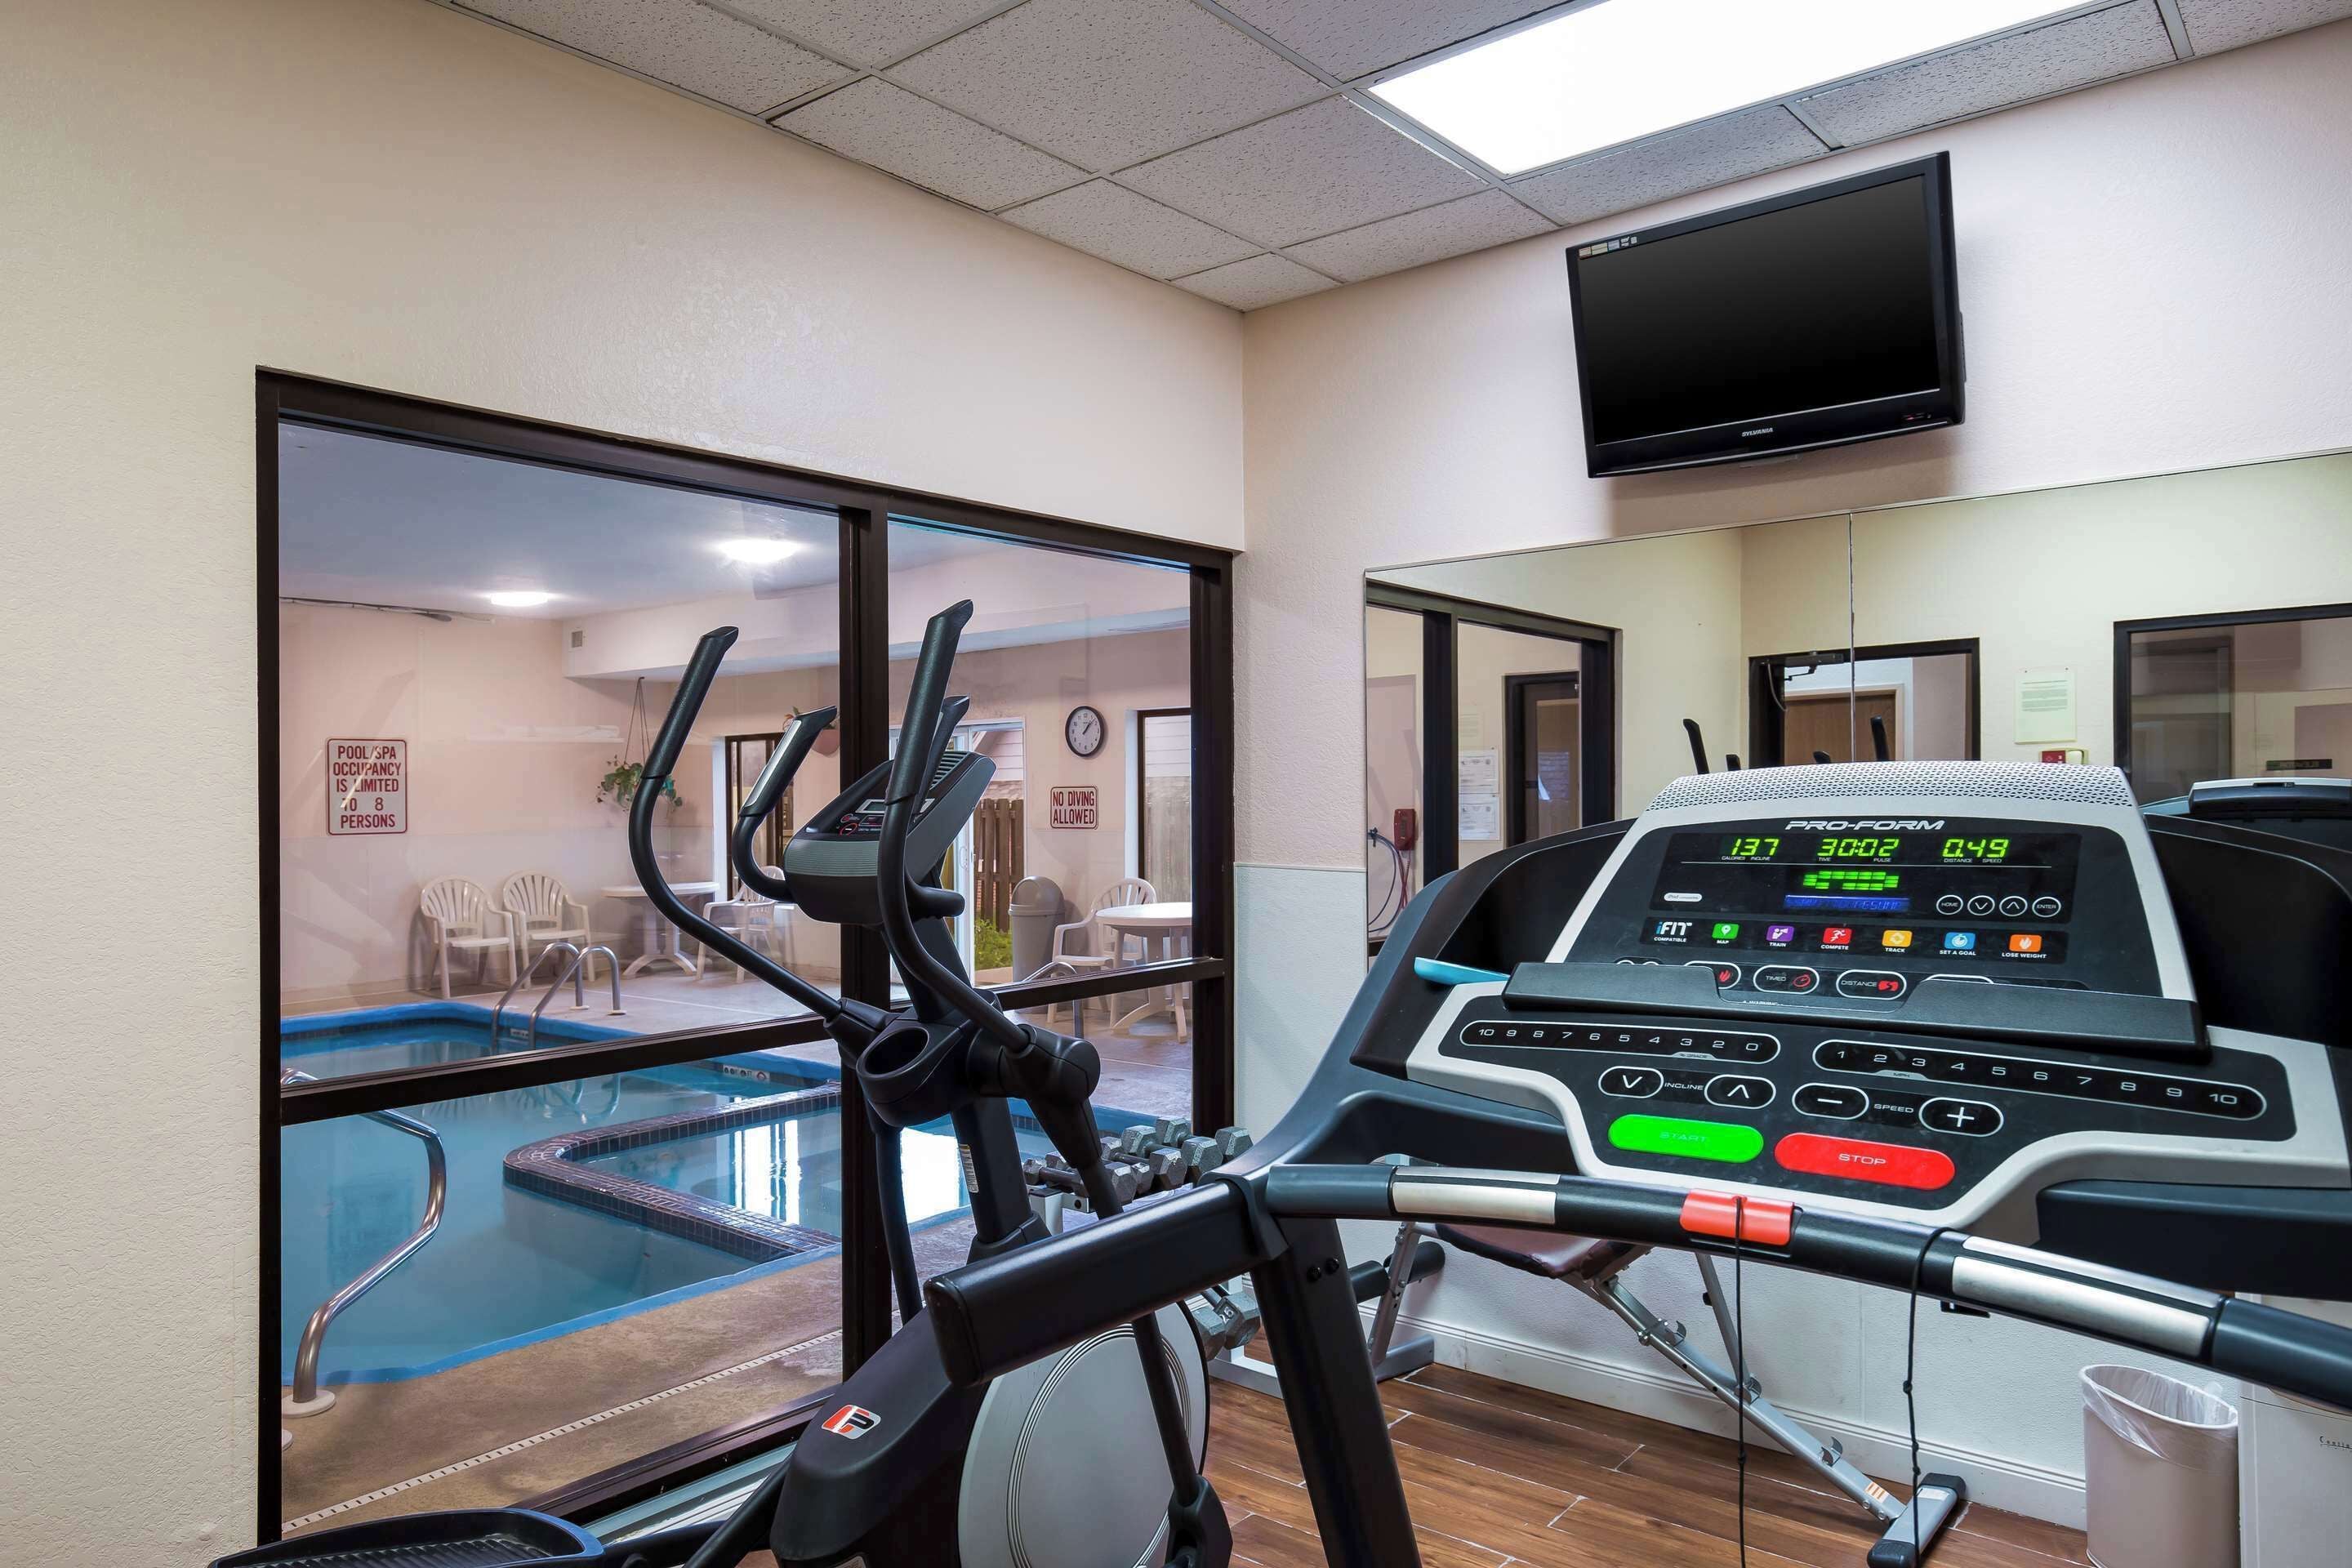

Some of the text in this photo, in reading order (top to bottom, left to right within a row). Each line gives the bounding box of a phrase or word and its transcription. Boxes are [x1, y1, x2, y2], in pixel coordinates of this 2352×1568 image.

[1741, 427, 1773, 437] SYLVANIA
[337, 745, 396, 760] POOL/SPA
[333, 762, 402, 776] OCCUPANCY
[336, 778, 399, 792] IS LIMITED
[375, 797, 383, 811] 8
[1053, 791, 1094, 807] NO DIVING
[341, 814, 395, 829] PERSONS
[1053, 809, 1095, 825] ALLOWED
[1784, 820, 1945, 831] PRO-FORM
[1731, 838, 1780, 857] 137
[1816, 838, 1900, 858] 30:02
[1478, 1028, 1759, 1052] 10 9 8 7 6 5 4 3 2 0
[1837, 1050, 2238, 1105] 1 2 3 4 5 6 7 8 9 10
[1664, 1082, 1704, 1091] INCLINE
[1873, 1103, 1915, 1114] SPEED
[1659, 1132, 1708, 1142] START
[1838, 1152, 1887, 1165] STOP
